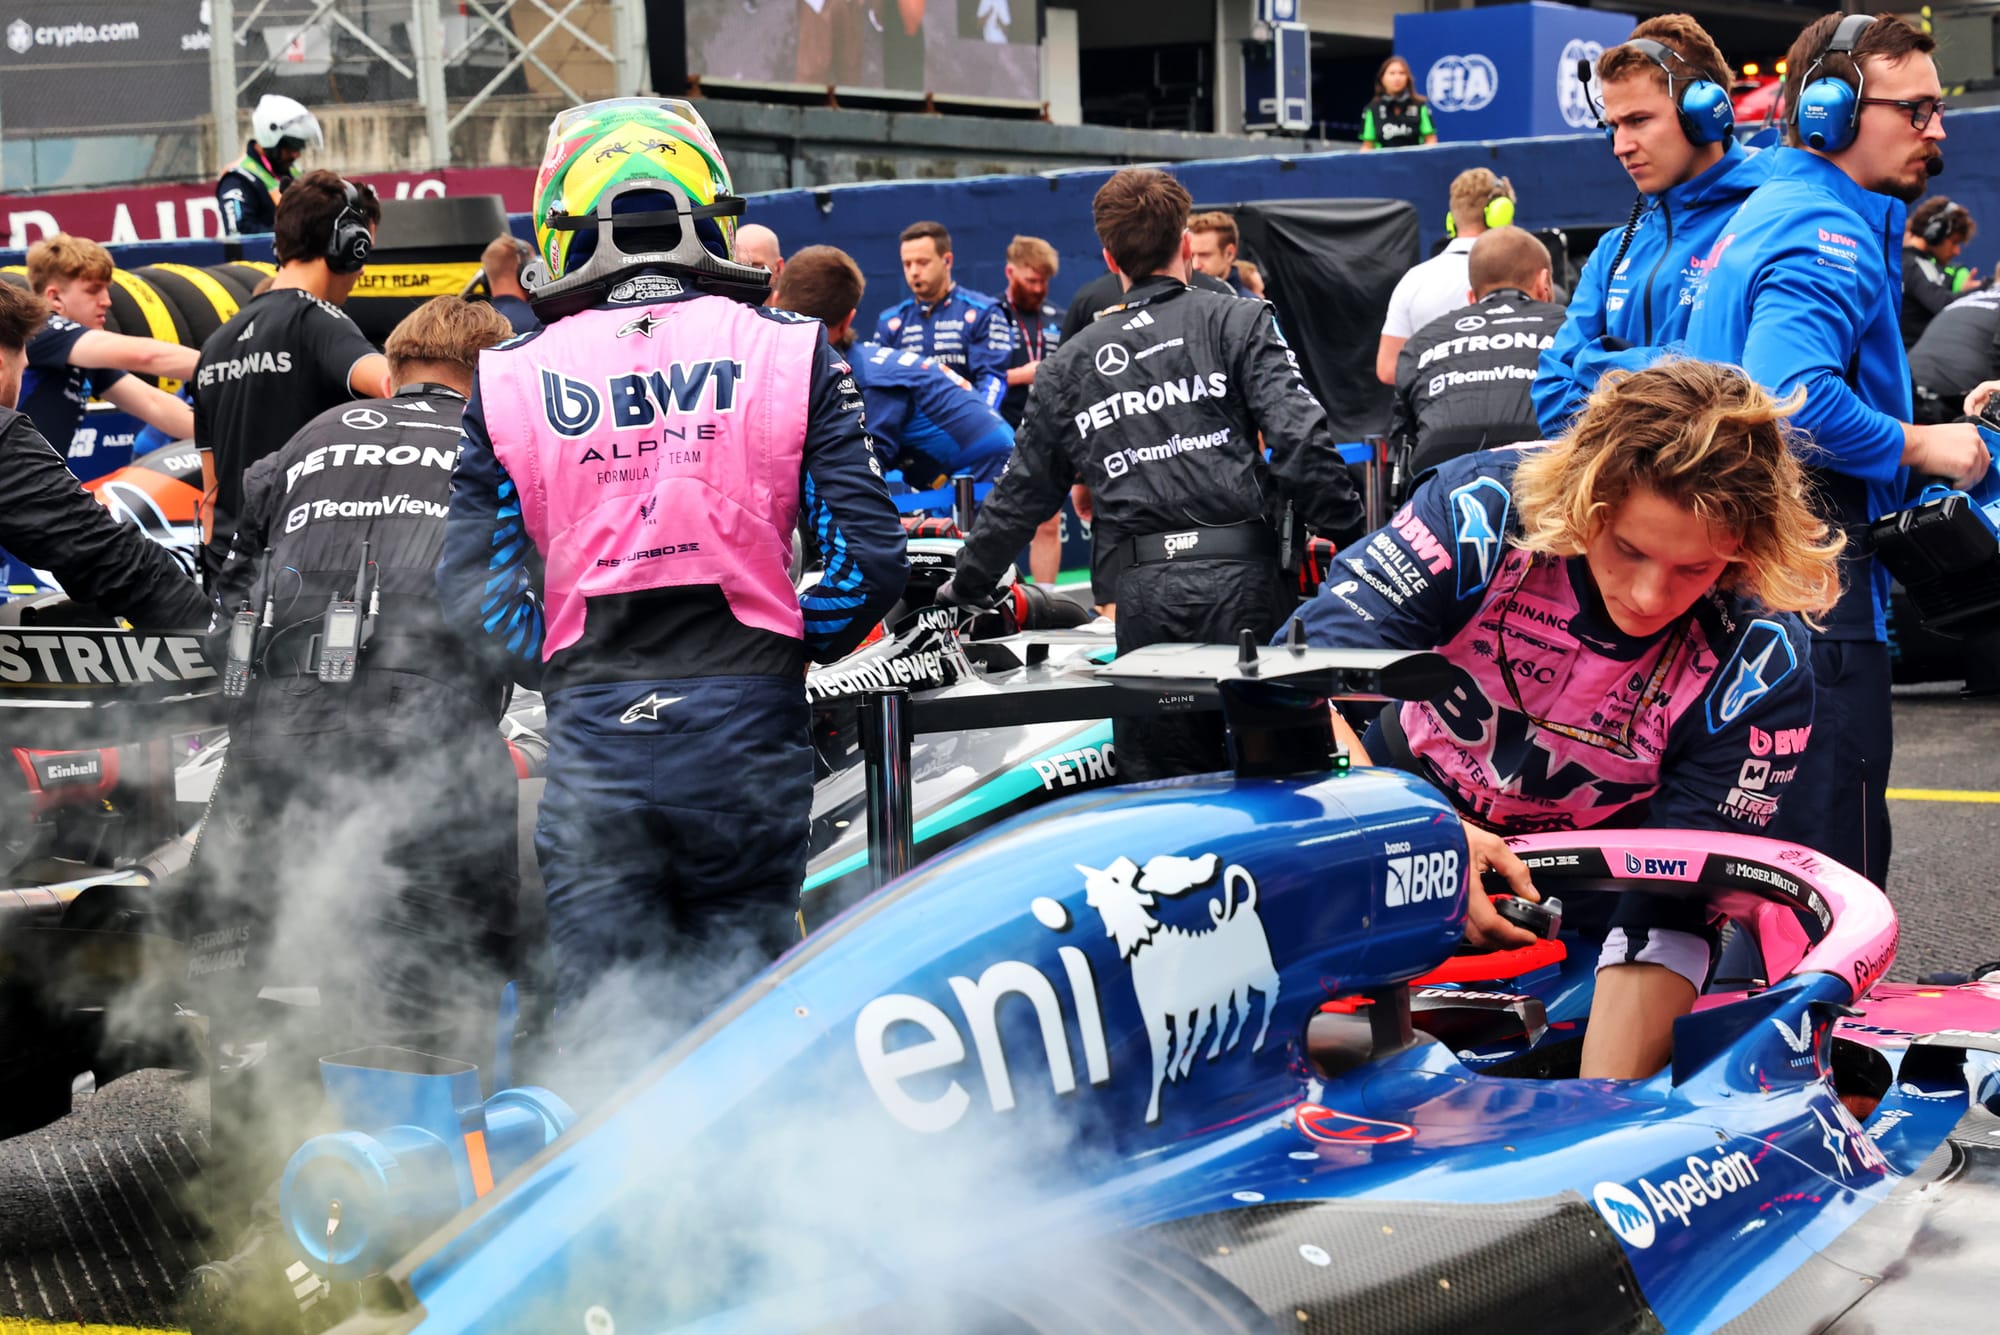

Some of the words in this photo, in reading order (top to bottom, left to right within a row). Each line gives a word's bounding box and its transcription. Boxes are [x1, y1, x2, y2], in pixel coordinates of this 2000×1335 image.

[35, 22, 139, 47] crypto.com
[1429, 64, 1492, 103] FIA
[622, 254, 679, 264] FEATHERLITE
[392, 274, 430, 288] REAR
[606, 359, 746, 431] BWT
[1074, 372, 1228, 440] PETRONAS
[102, 434, 134, 447] ALEX
[579, 422, 717, 464] ALPNE
[1124, 427, 1231, 466] TeamViewer
[286, 444, 456, 494] PETRON
[596, 468, 650, 485] FORMULA
[669, 450, 701, 465] TEAM
[311, 494, 449, 519] TeamView
[1164, 531, 1199, 550] OMP
[1399, 516, 1453, 576] BWT
[917, 612, 948, 631] AMD
[0, 636, 217, 684] STRIKE
[1158, 695, 1195, 704] ALPINE
[48, 761, 97, 779] Einhell
[1385, 842, 1411, 853] banco
[1412, 850, 1459, 903] BRB
[1645, 858, 1688, 876] BWT
[1417, 988, 1530, 1001] Delphi
[855, 896, 1110, 1132] eni
[1639, 1145, 1760, 1226] ApeCoin
